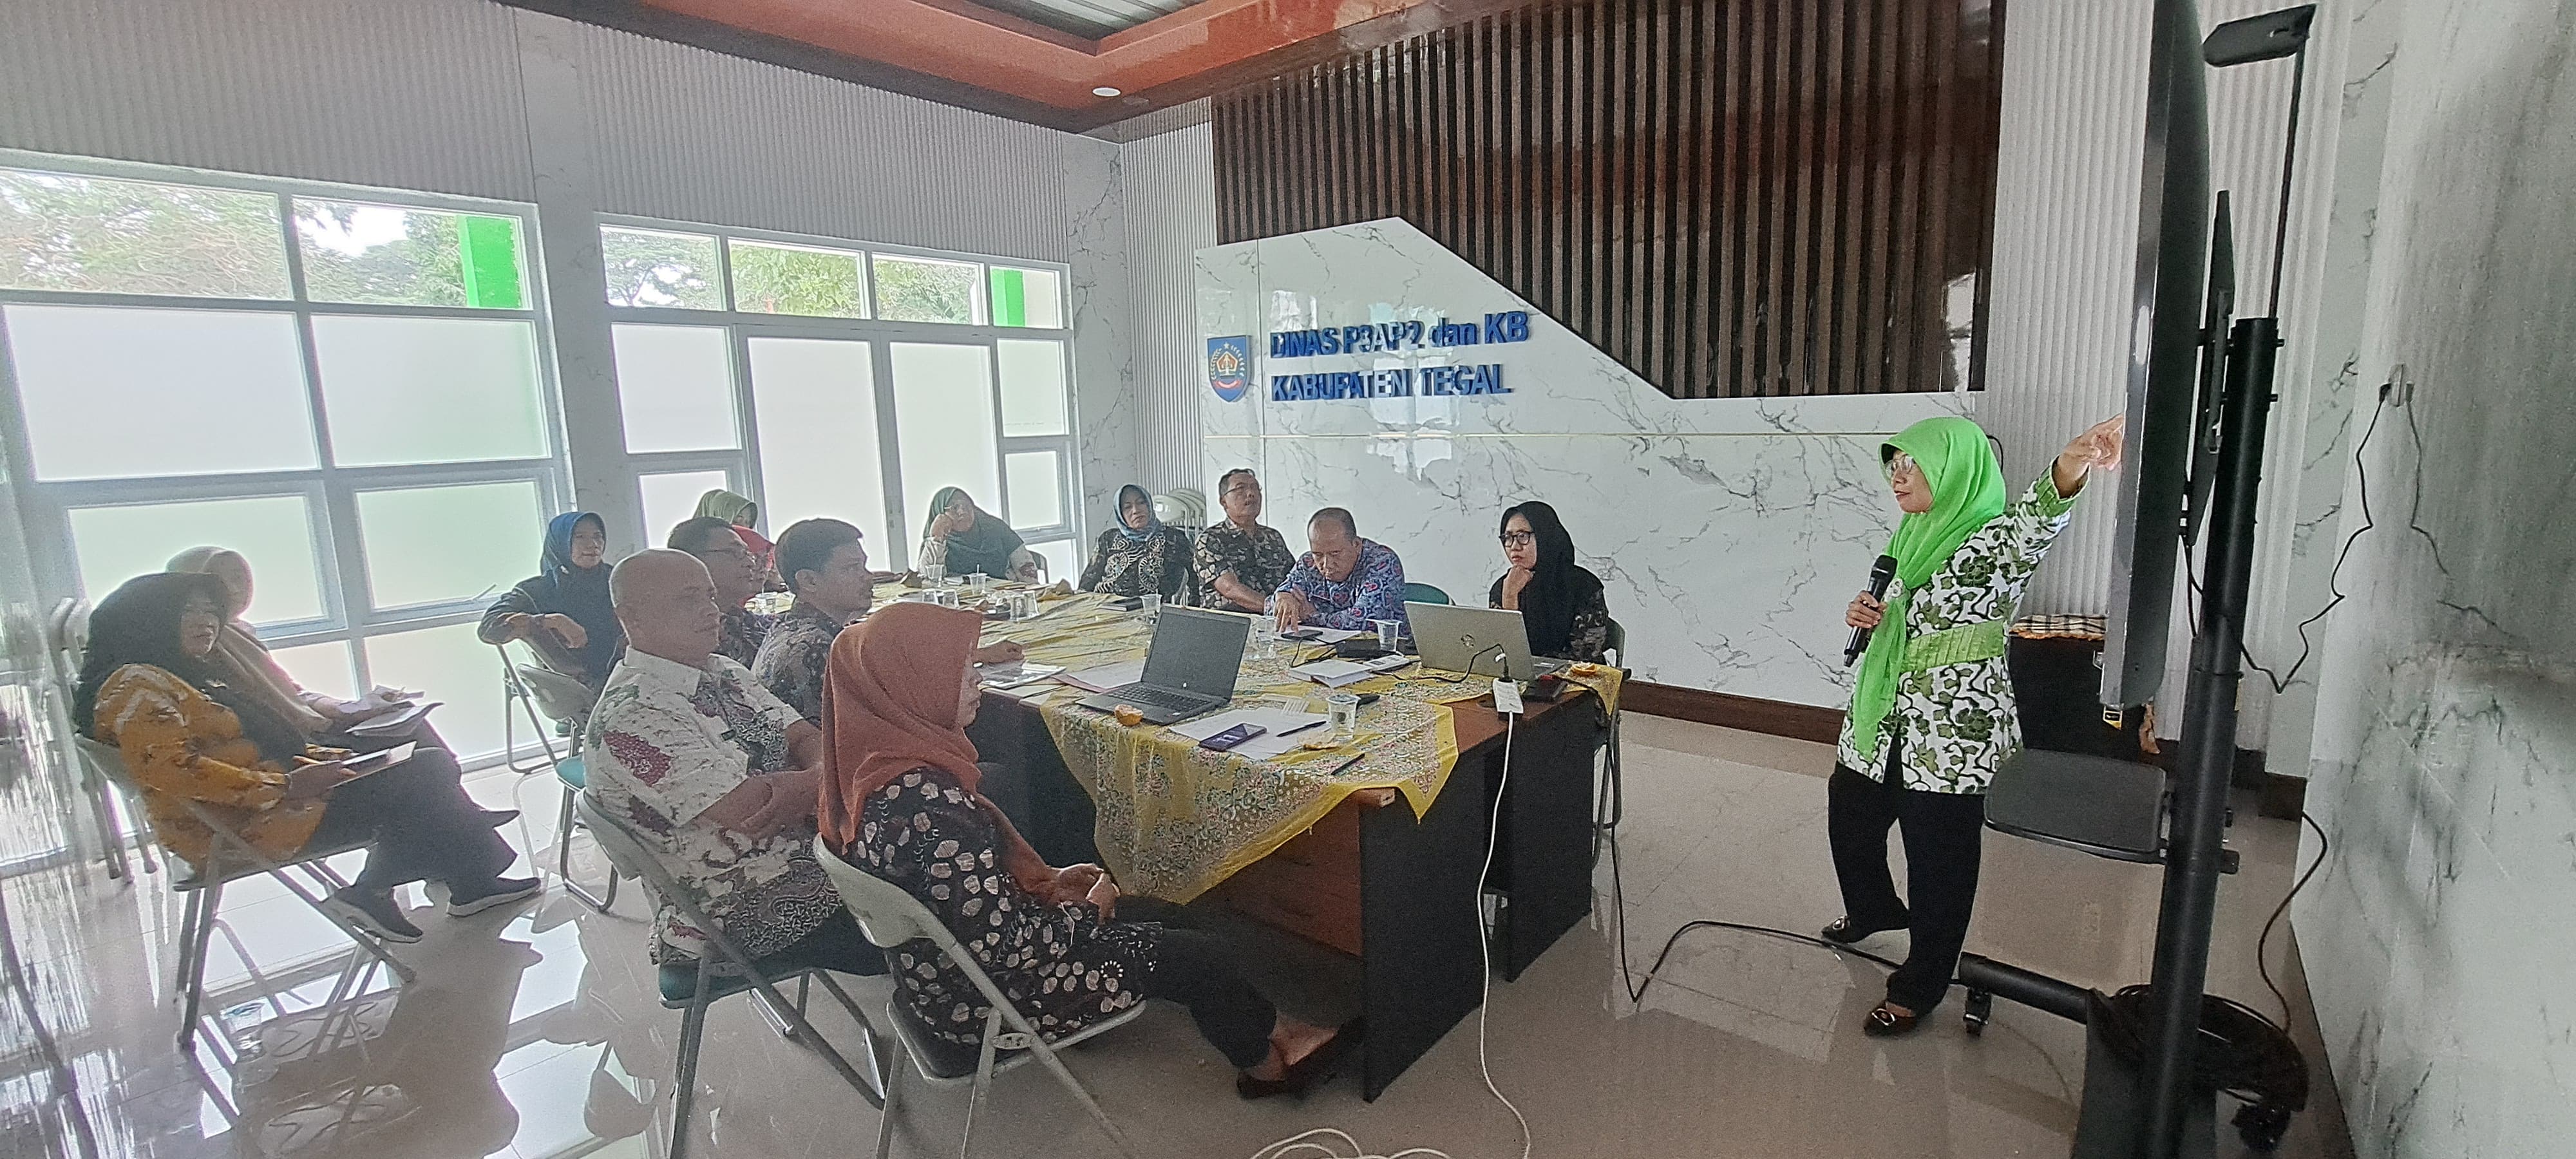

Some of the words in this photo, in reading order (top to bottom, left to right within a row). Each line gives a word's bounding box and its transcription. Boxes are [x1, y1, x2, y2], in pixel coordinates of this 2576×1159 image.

[1270, 327, 1341, 358] DINAS
[1343, 321, 1425, 354] P3AP2
[1428, 317, 1478, 348] dan
[1484, 311, 1530, 344] KB
[1271, 368, 1414, 402] KABUPATEN
[1419, 364, 1514, 397] TEGAL
